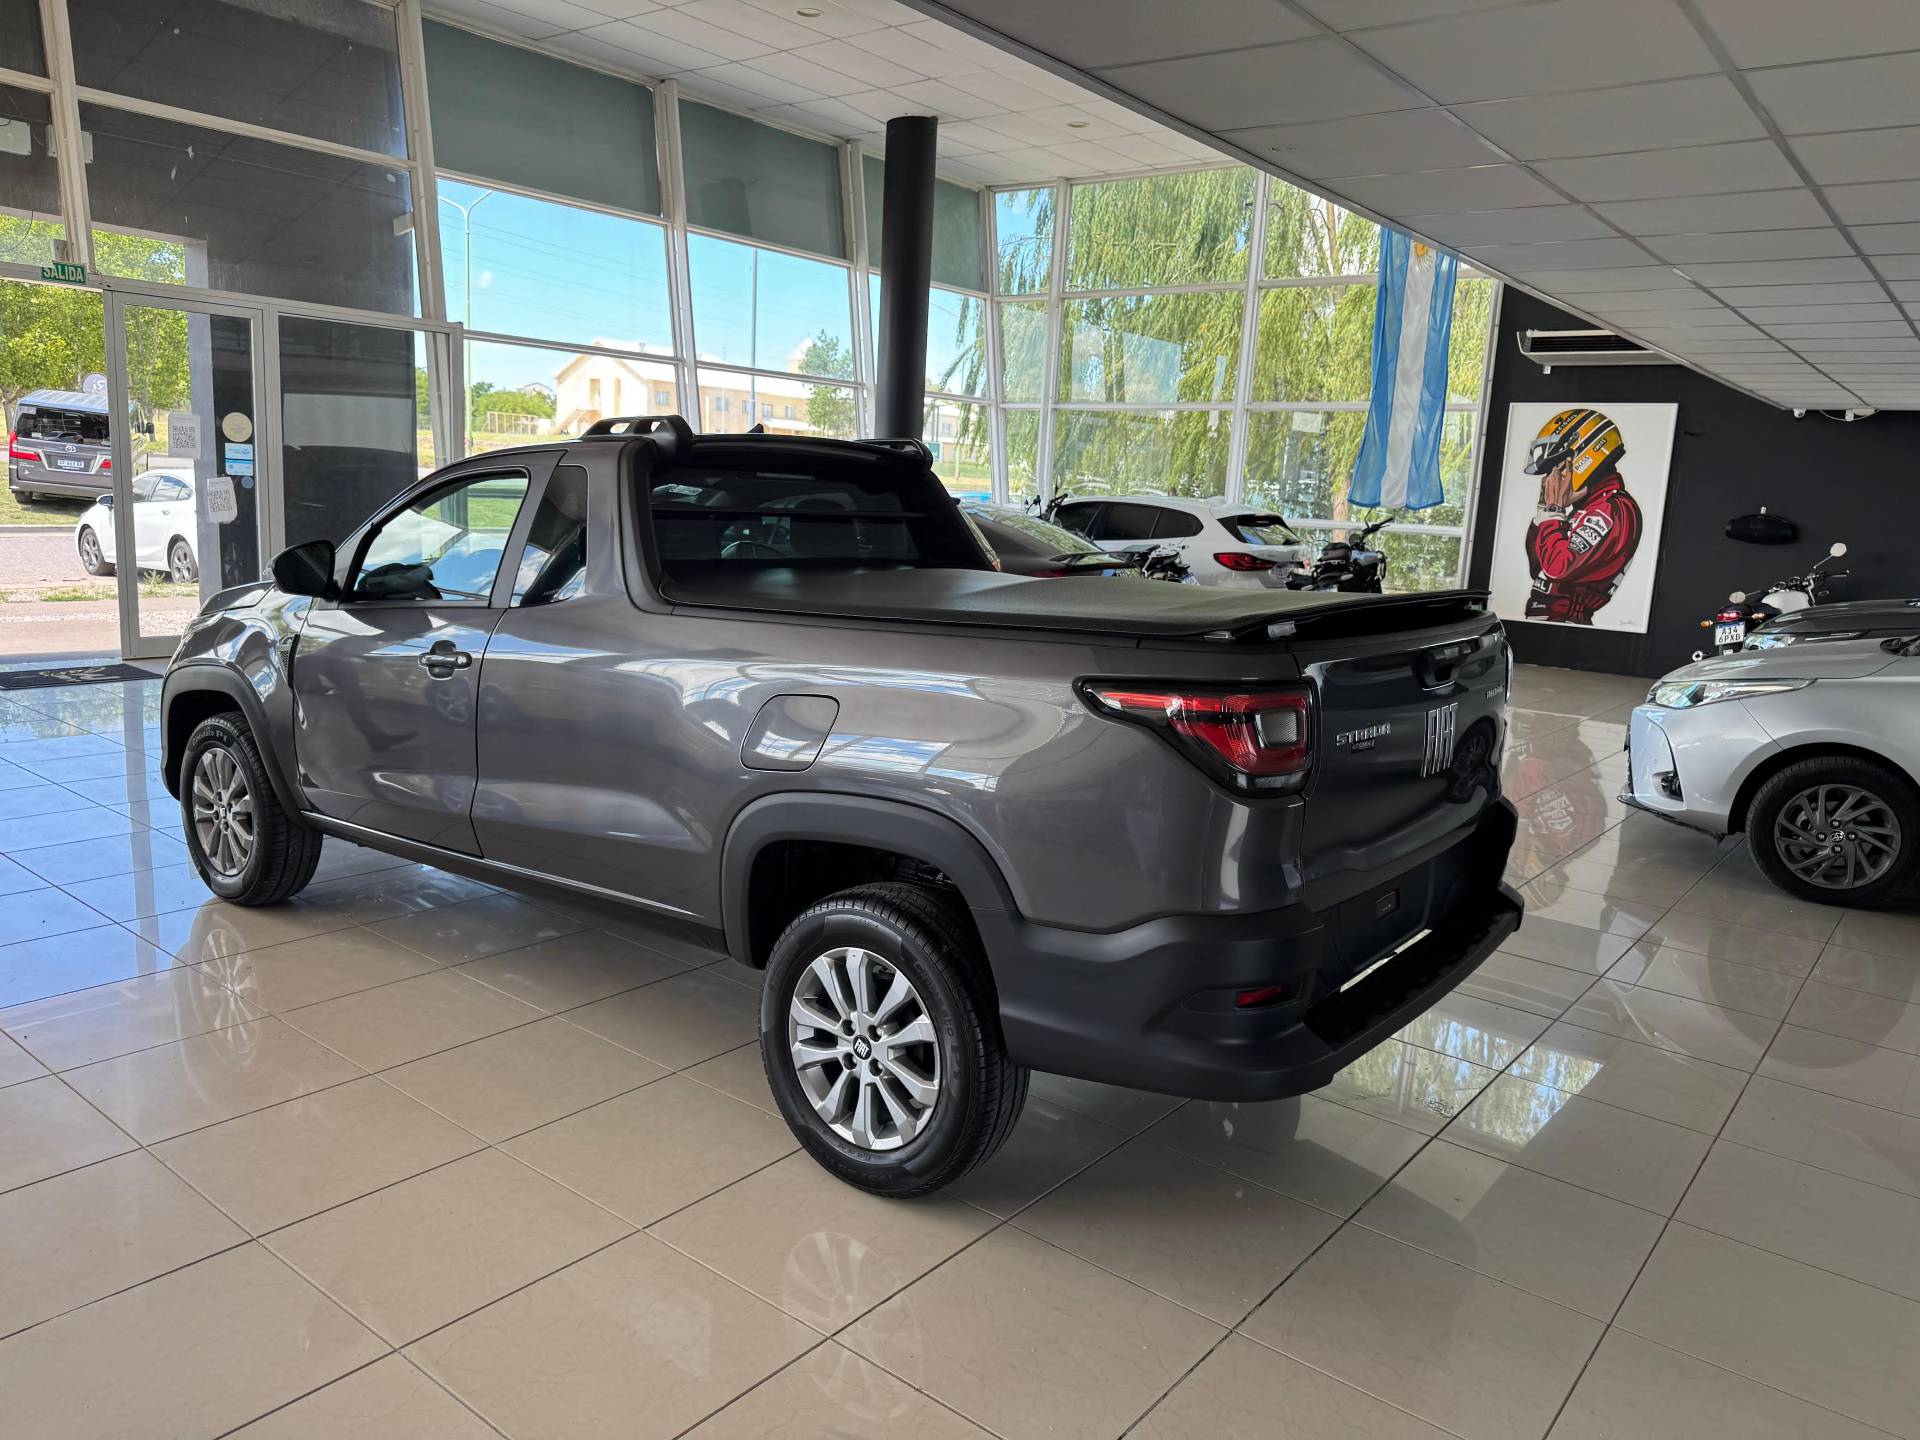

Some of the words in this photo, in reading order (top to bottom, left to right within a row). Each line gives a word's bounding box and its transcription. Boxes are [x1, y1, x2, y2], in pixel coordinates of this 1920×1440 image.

[43, 265, 84, 282] SALIDA
[1336, 722, 1391, 746] STRADA
[1420, 702, 1459, 778] FIAT
[854, 1038, 870, 1058] FIAT
